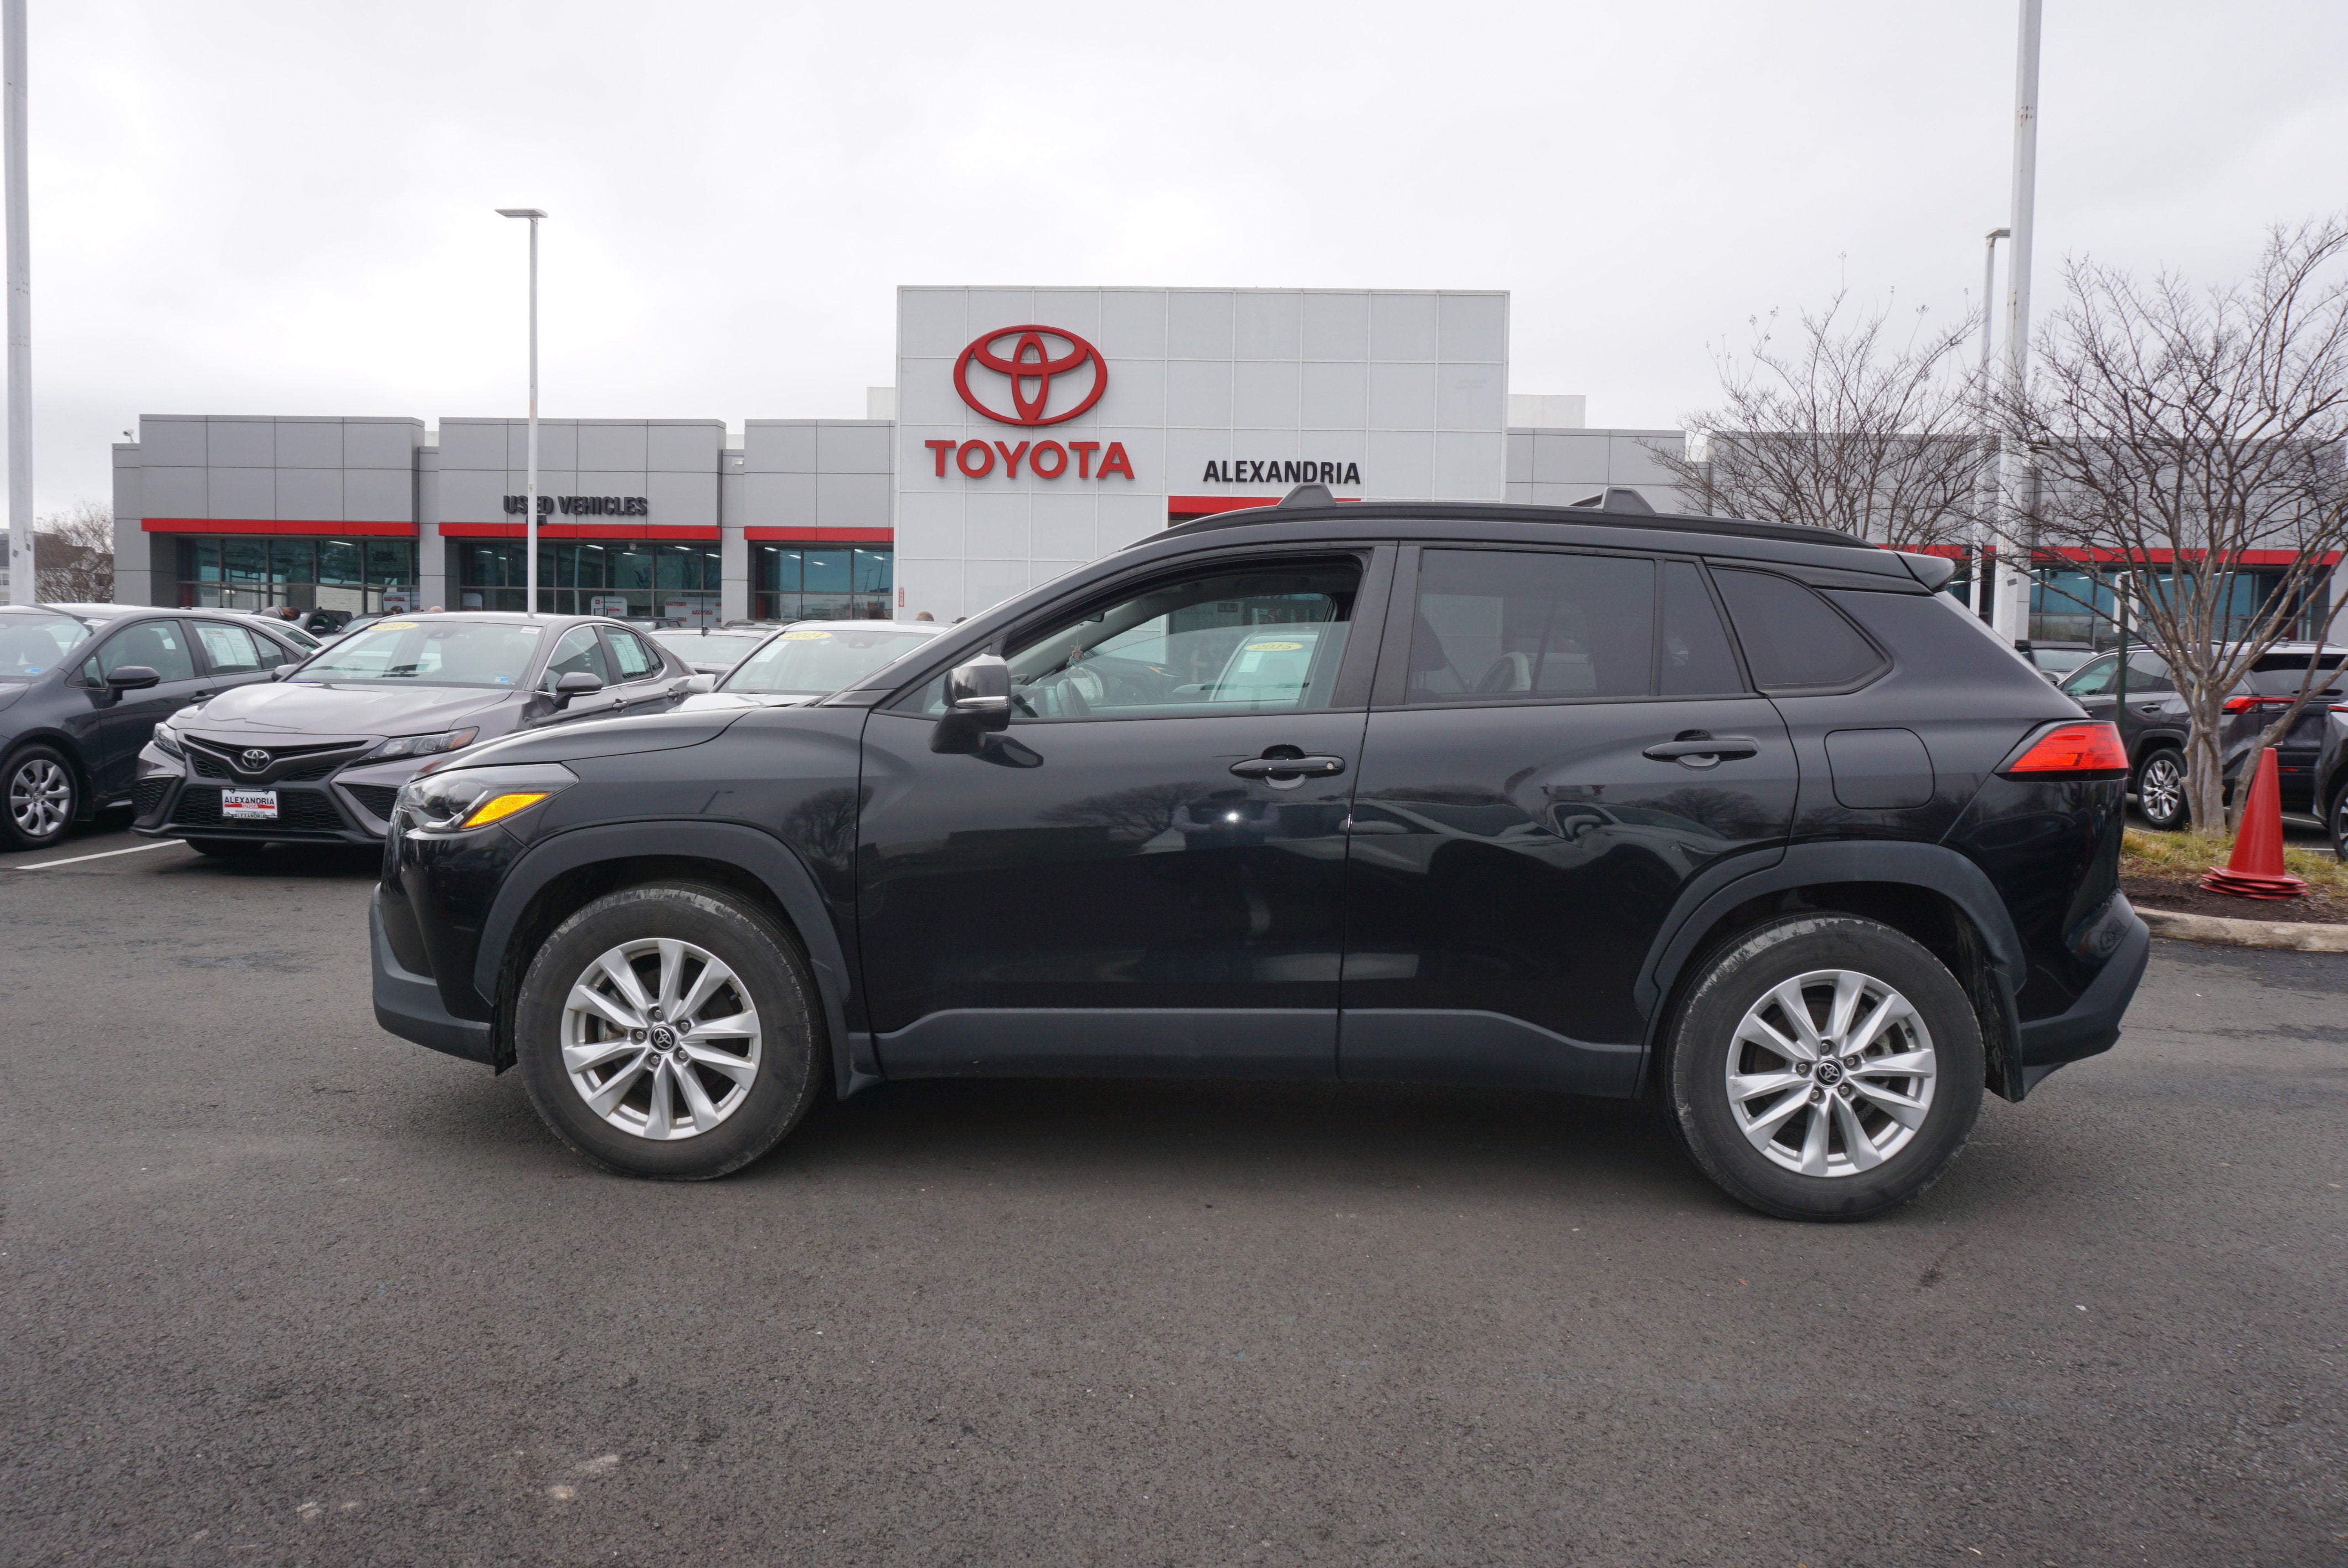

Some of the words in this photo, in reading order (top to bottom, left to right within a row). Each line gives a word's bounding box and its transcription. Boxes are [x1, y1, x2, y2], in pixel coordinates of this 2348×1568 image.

[925, 439, 1135, 479] TOYOTA
[1203, 460, 1361, 484] ALEXANDRIA
[557, 496, 647, 515] VEHICLES
